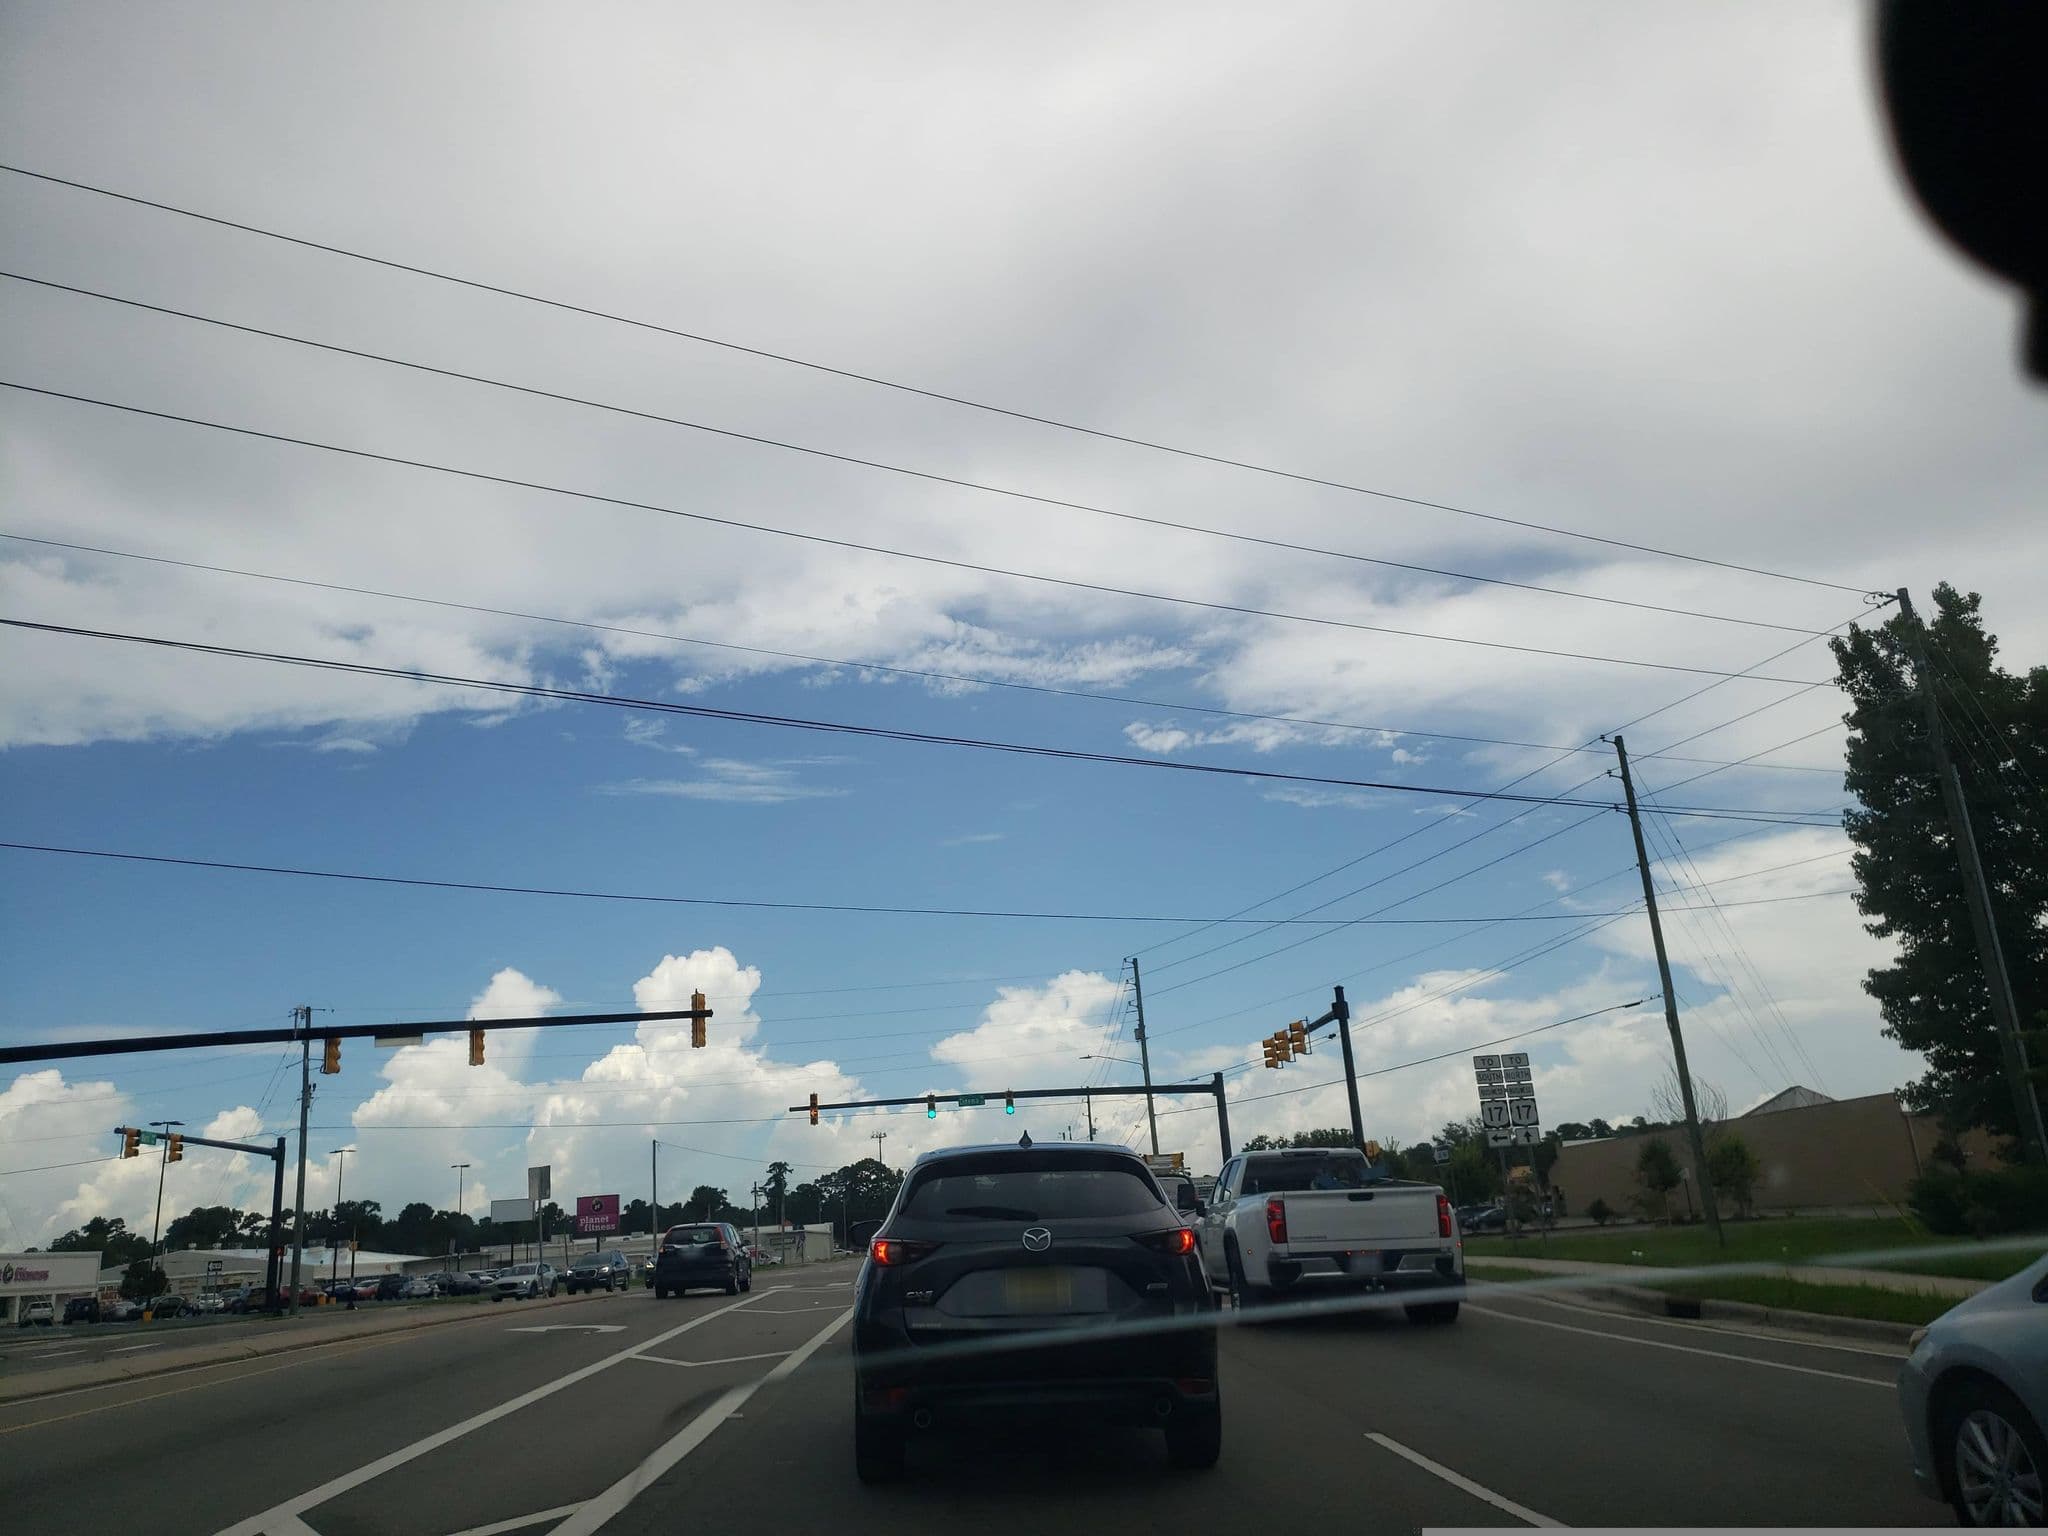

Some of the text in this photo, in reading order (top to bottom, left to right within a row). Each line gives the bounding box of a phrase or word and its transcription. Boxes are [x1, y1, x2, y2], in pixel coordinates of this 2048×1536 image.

[1481, 1058, 1494, 1066] TO
[1509, 1056, 1522, 1065] TO
[1505, 1070, 1529, 1080] NORTH
[1488, 1106, 1503, 1121] 17
[1516, 1105, 1531, 1120] 17
[580, 1216, 609, 1226] planet
[584, 1223, 616, 1232] fitness
